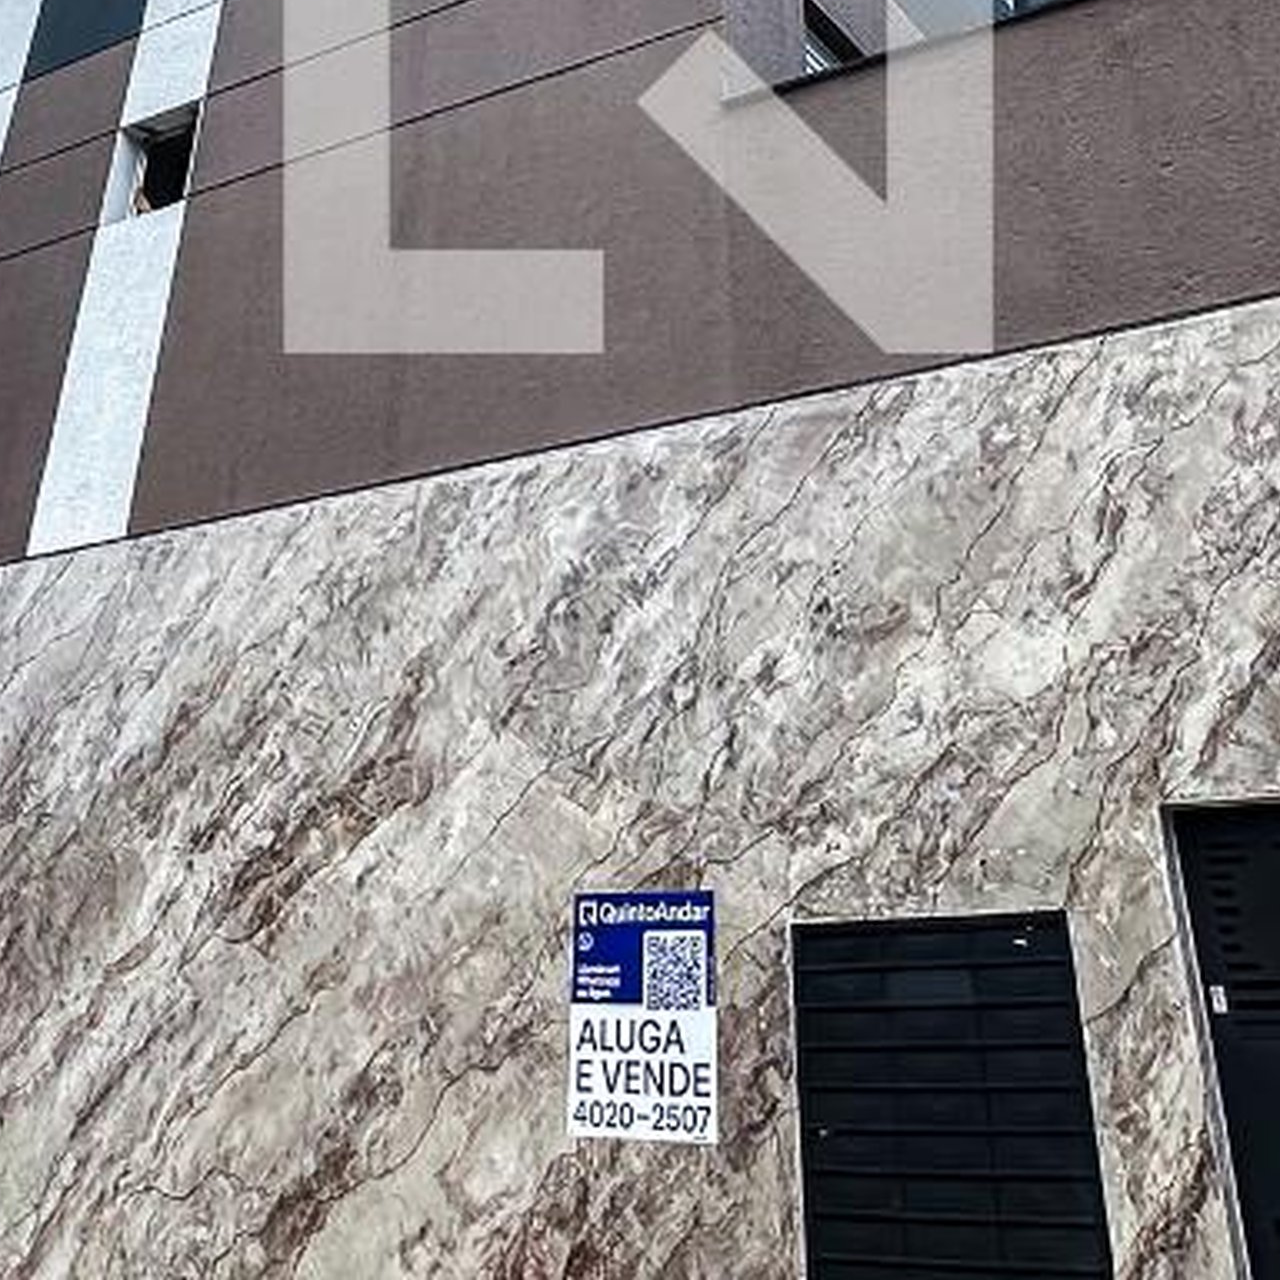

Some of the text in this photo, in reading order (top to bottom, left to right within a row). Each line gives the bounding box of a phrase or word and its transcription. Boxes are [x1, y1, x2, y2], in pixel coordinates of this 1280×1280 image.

[599, 900, 711, 923] QuintoAndar
[576, 1019, 686, 1054] ALUGA
[576, 1059, 711, 1098] E VENDE
[573, 1101, 712, 1134] 4020-2507
